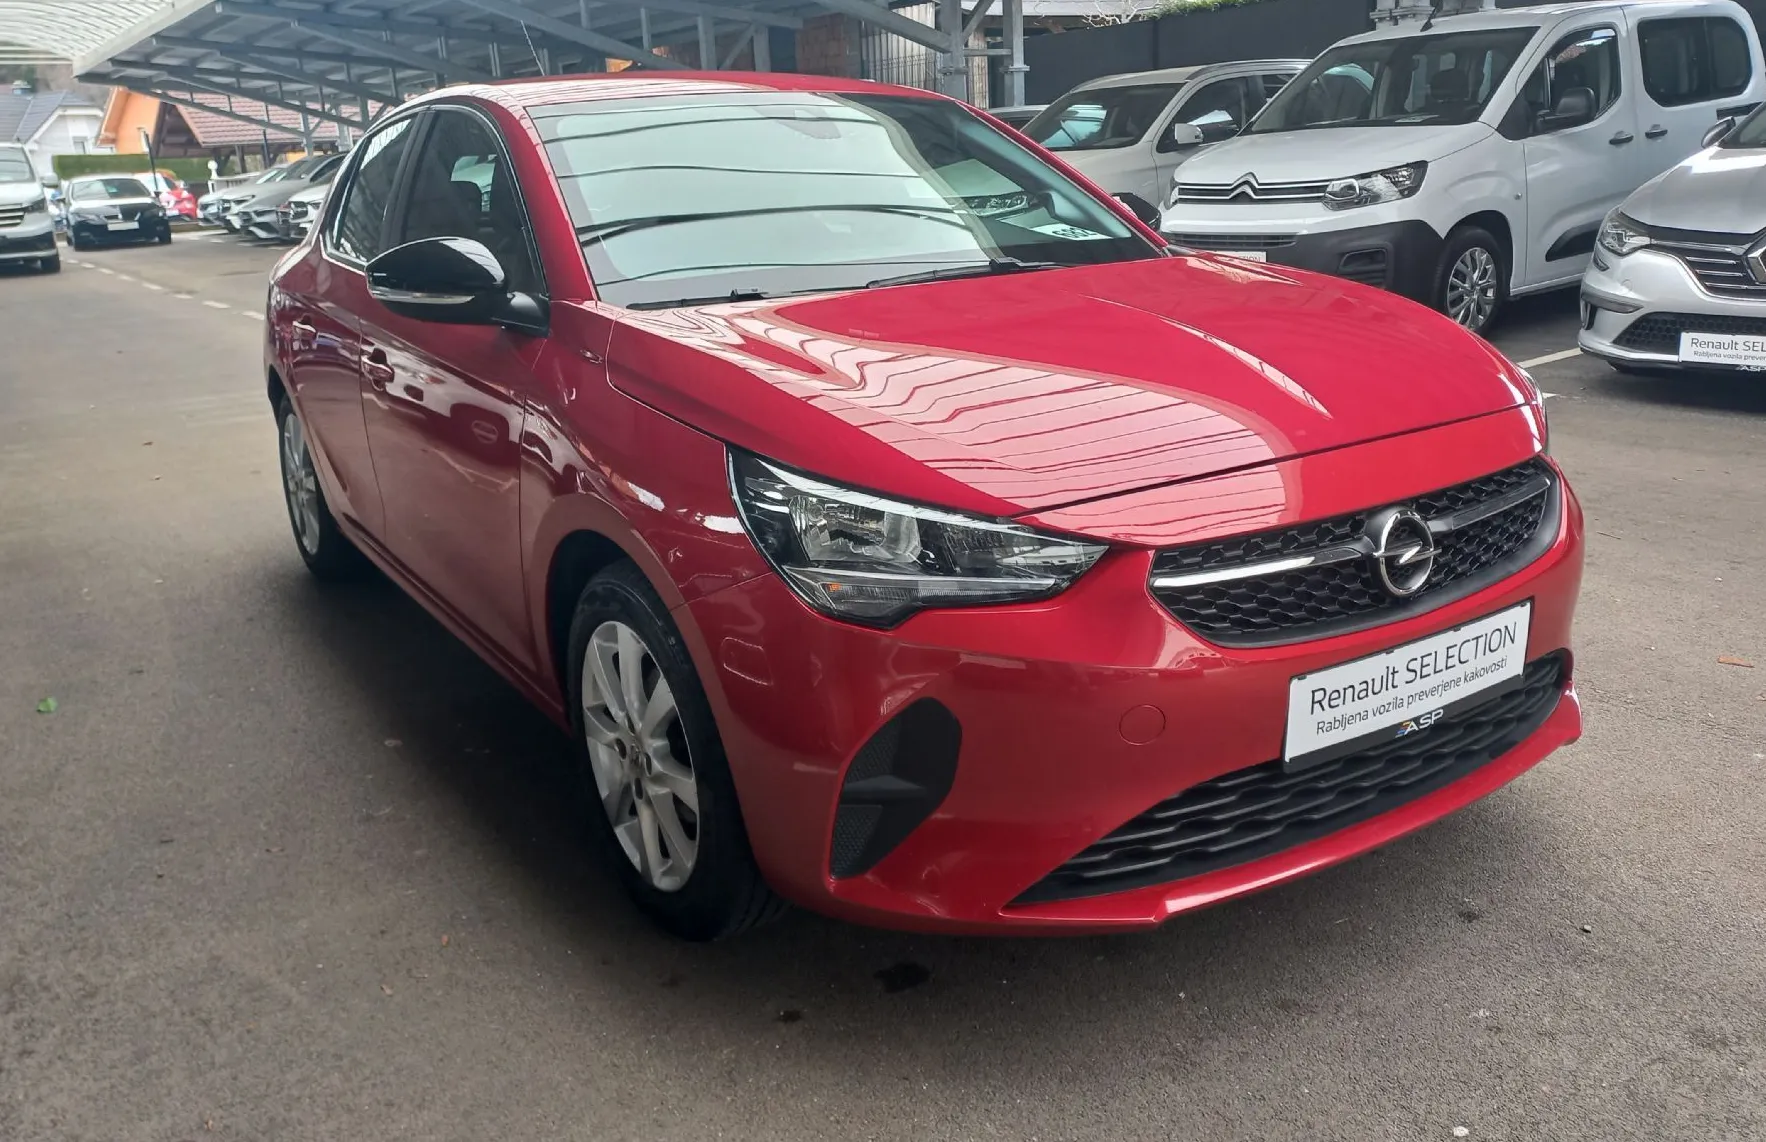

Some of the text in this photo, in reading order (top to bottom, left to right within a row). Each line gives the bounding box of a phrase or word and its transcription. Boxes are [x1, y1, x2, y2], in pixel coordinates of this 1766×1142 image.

[1691, 338, 1739, 350] Renault
[1310, 621, 1517, 716] Renault SELECTION
[1316, 655, 1508, 736] Rabljena vozila preverjene kakovosti
[1404, 708, 1444, 736] ASP
